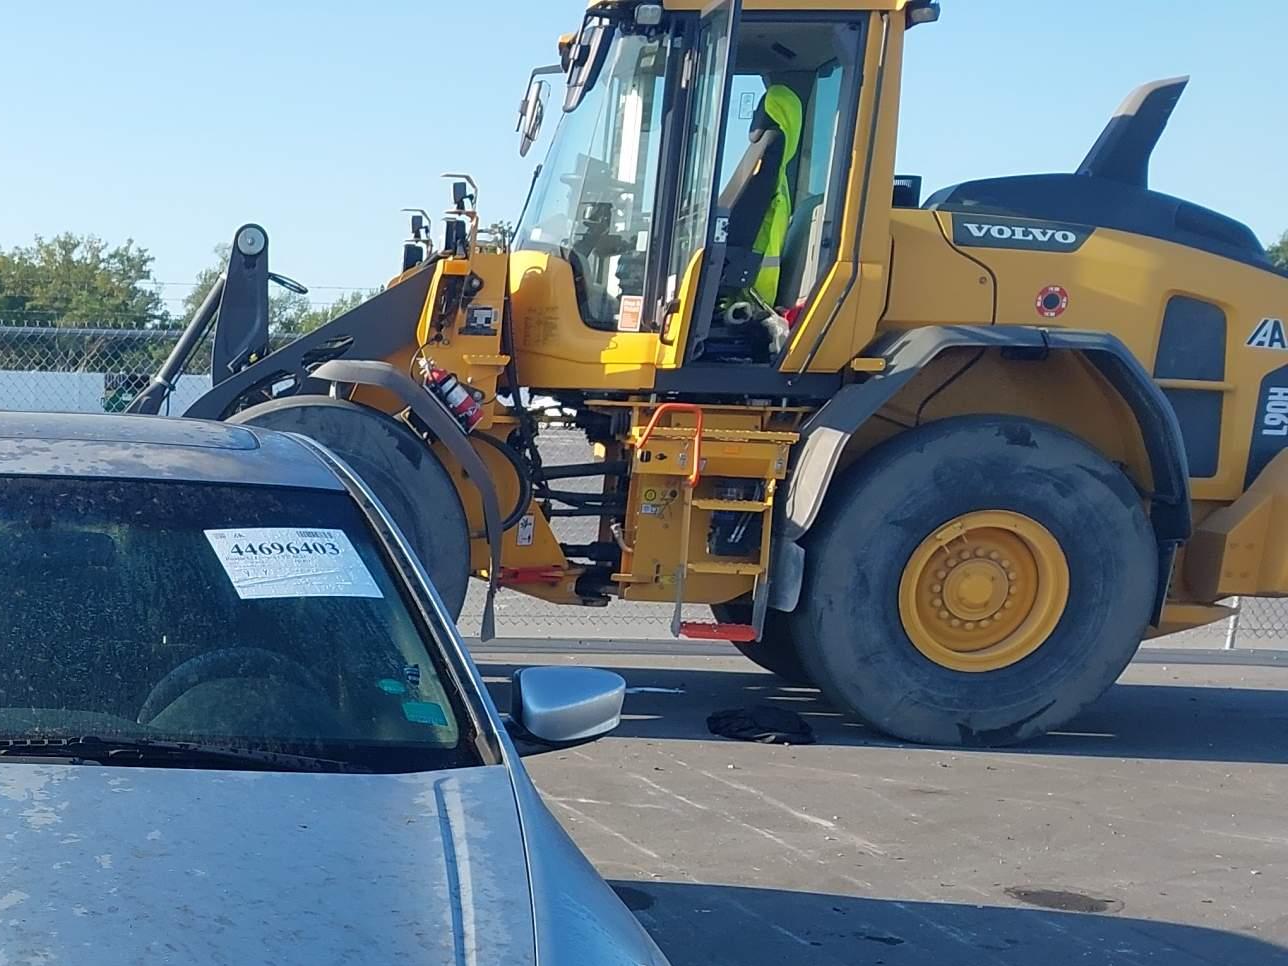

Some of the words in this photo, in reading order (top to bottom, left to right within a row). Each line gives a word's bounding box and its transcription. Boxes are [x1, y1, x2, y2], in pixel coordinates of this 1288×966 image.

[963, 223, 1076, 243] VOLVO
[1262, 387, 1288, 436] L90H
[230, 541, 341, 556] 44696403
